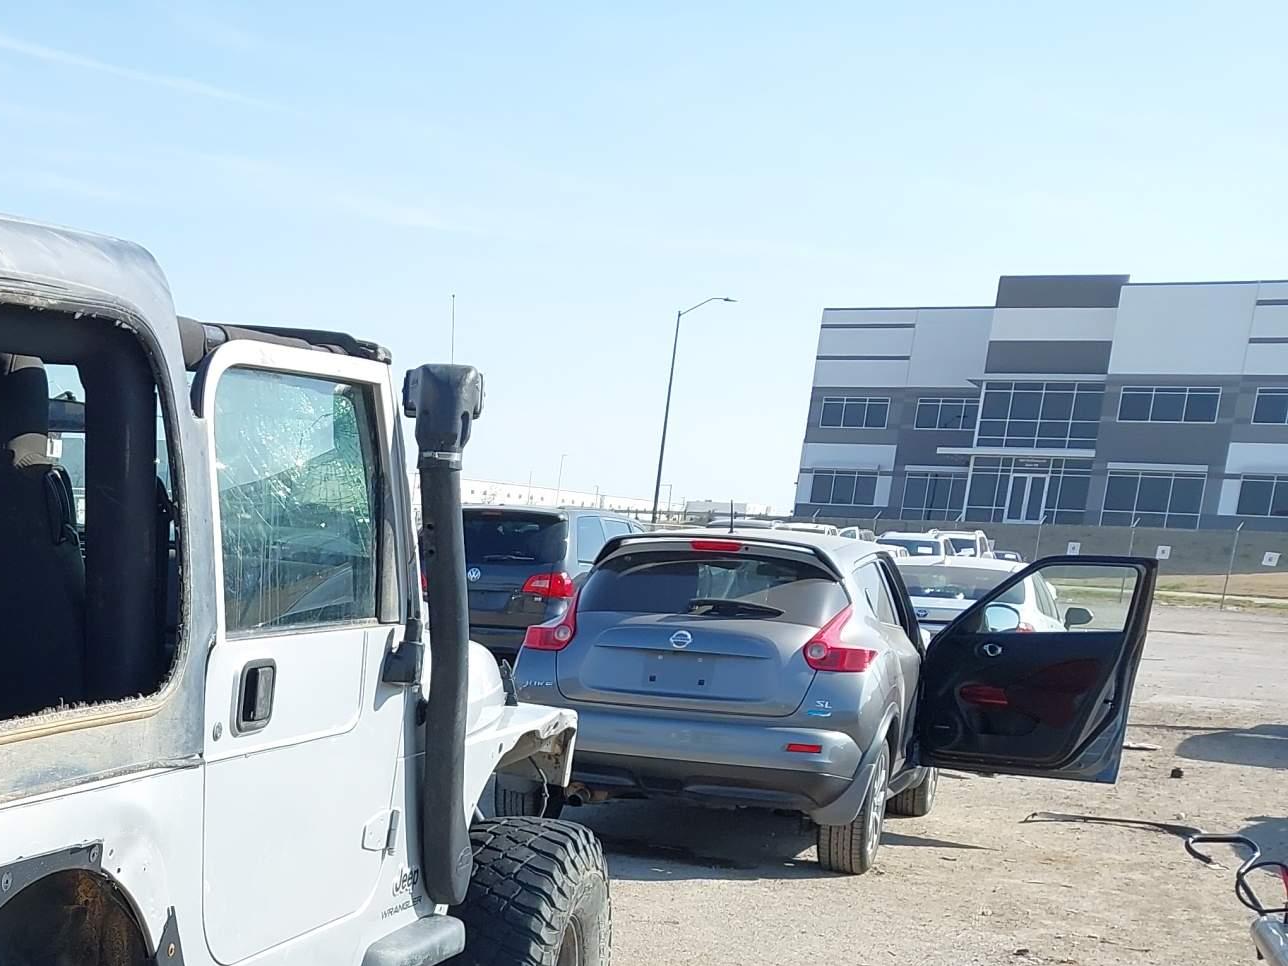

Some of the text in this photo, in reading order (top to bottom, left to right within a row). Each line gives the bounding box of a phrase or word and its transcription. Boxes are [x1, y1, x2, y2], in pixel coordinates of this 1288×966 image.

[522, 679, 553, 688] JUKE
[815, 700, 833, 709] SL
[394, 867, 419, 894] Jeep
[380, 895, 423, 921] WRANGLER
